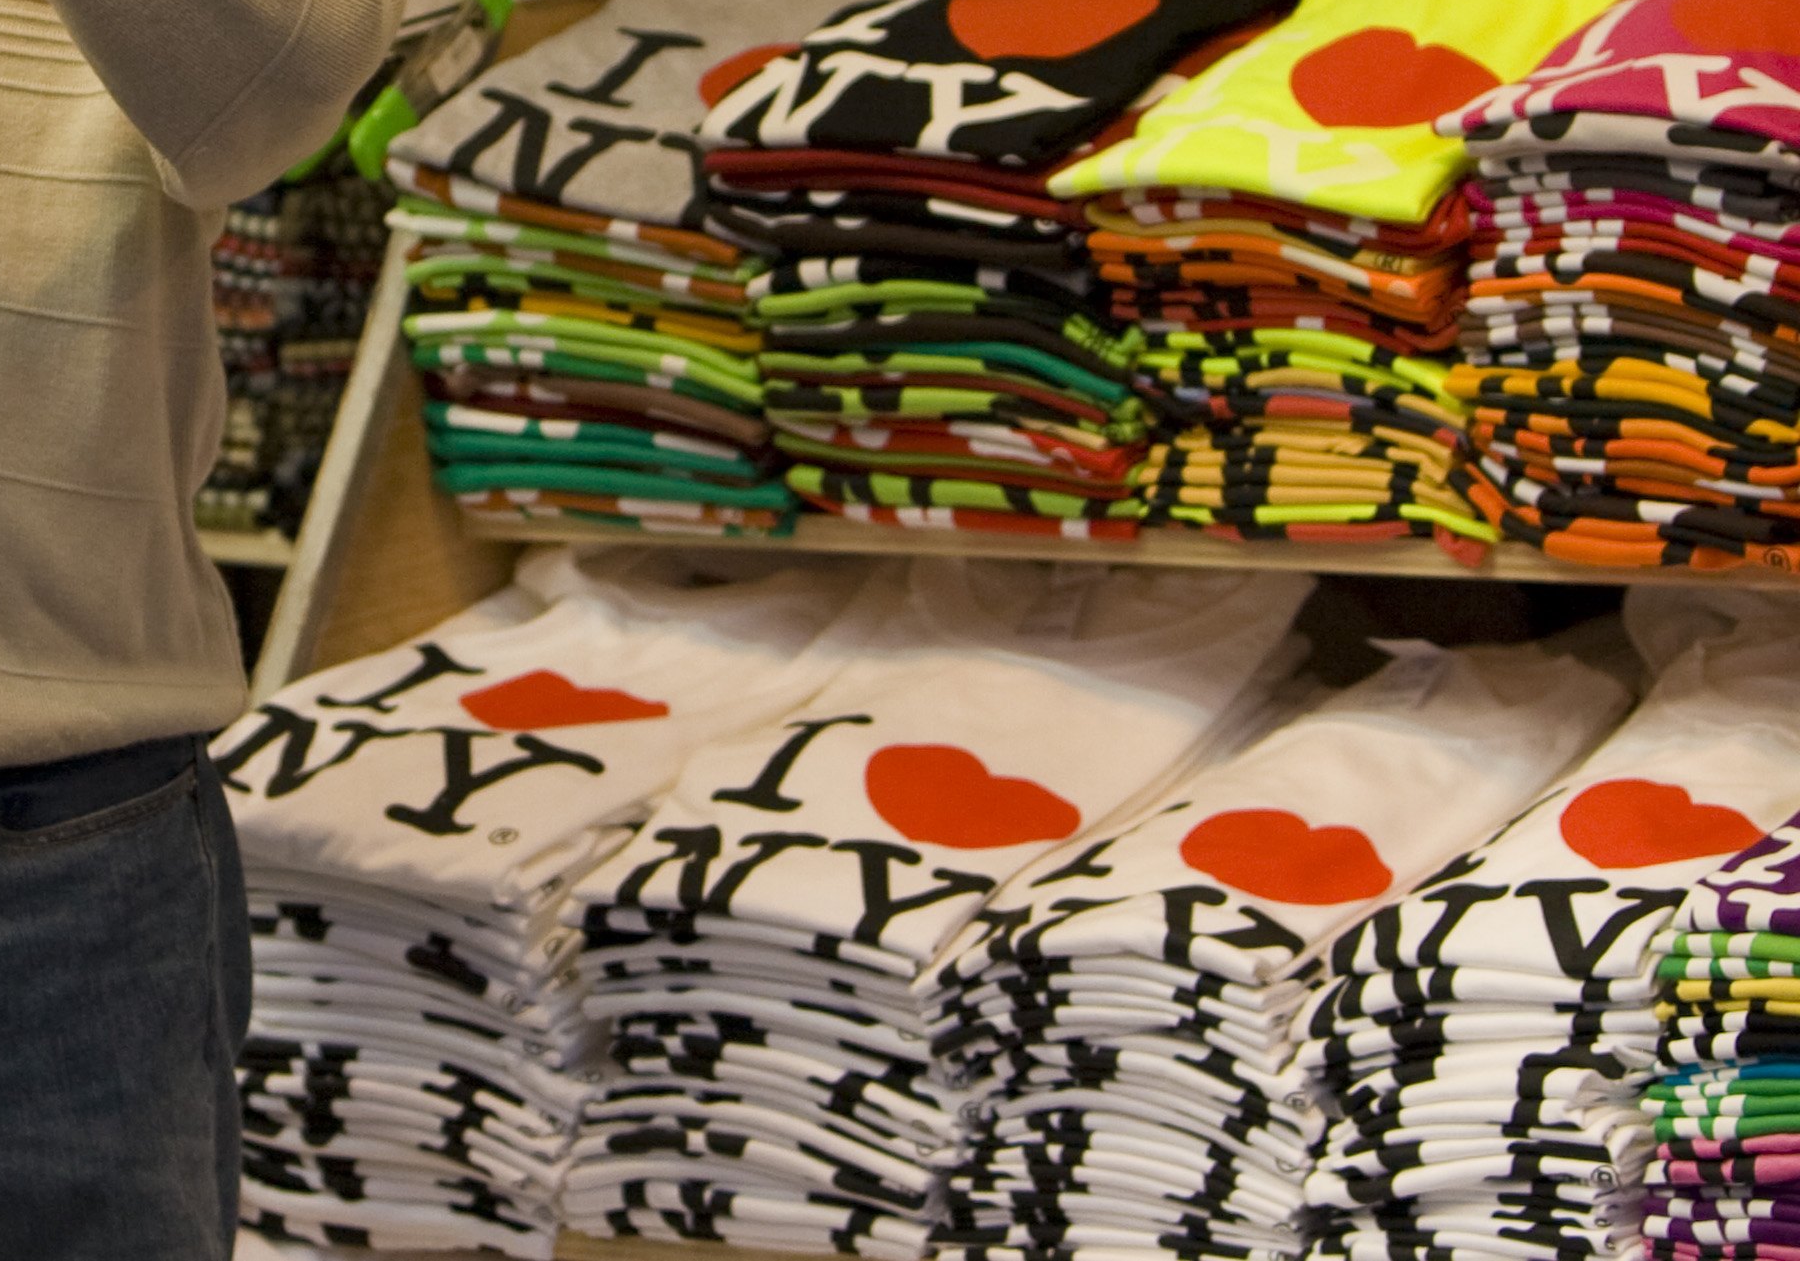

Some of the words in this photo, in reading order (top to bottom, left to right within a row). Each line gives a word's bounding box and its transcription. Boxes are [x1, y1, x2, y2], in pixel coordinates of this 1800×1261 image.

[545, 26, 705, 108] I
[700, 48, 1093, 160] NY
[213, 703, 605, 836] NY
[711, 713, 874, 813] I
[615, 824, 997, 947] NY
